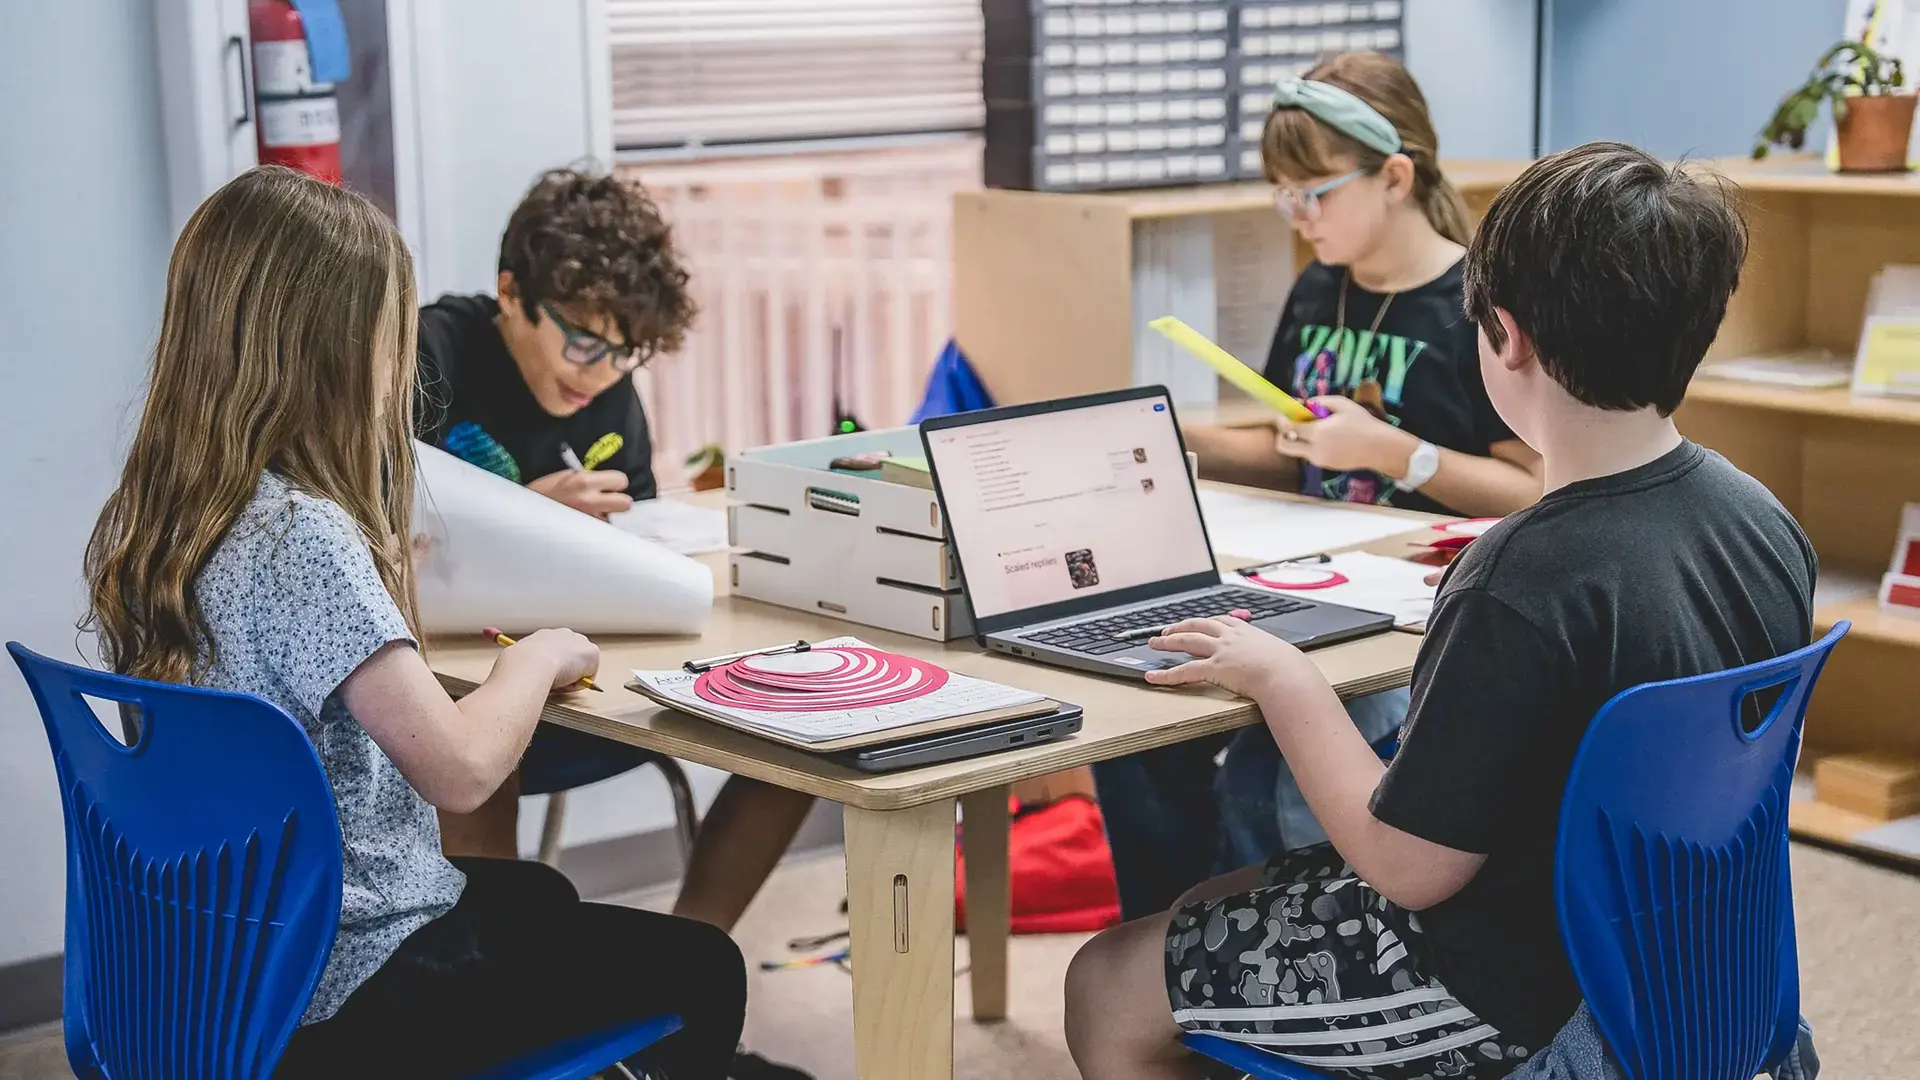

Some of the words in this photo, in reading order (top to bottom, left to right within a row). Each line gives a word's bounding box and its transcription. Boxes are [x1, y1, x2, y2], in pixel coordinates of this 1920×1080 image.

[1299, 324, 1429, 404] ZOEY
[1004, 561, 1030, 574] Scaled
[1030, 557, 1057, 570] reptiles
